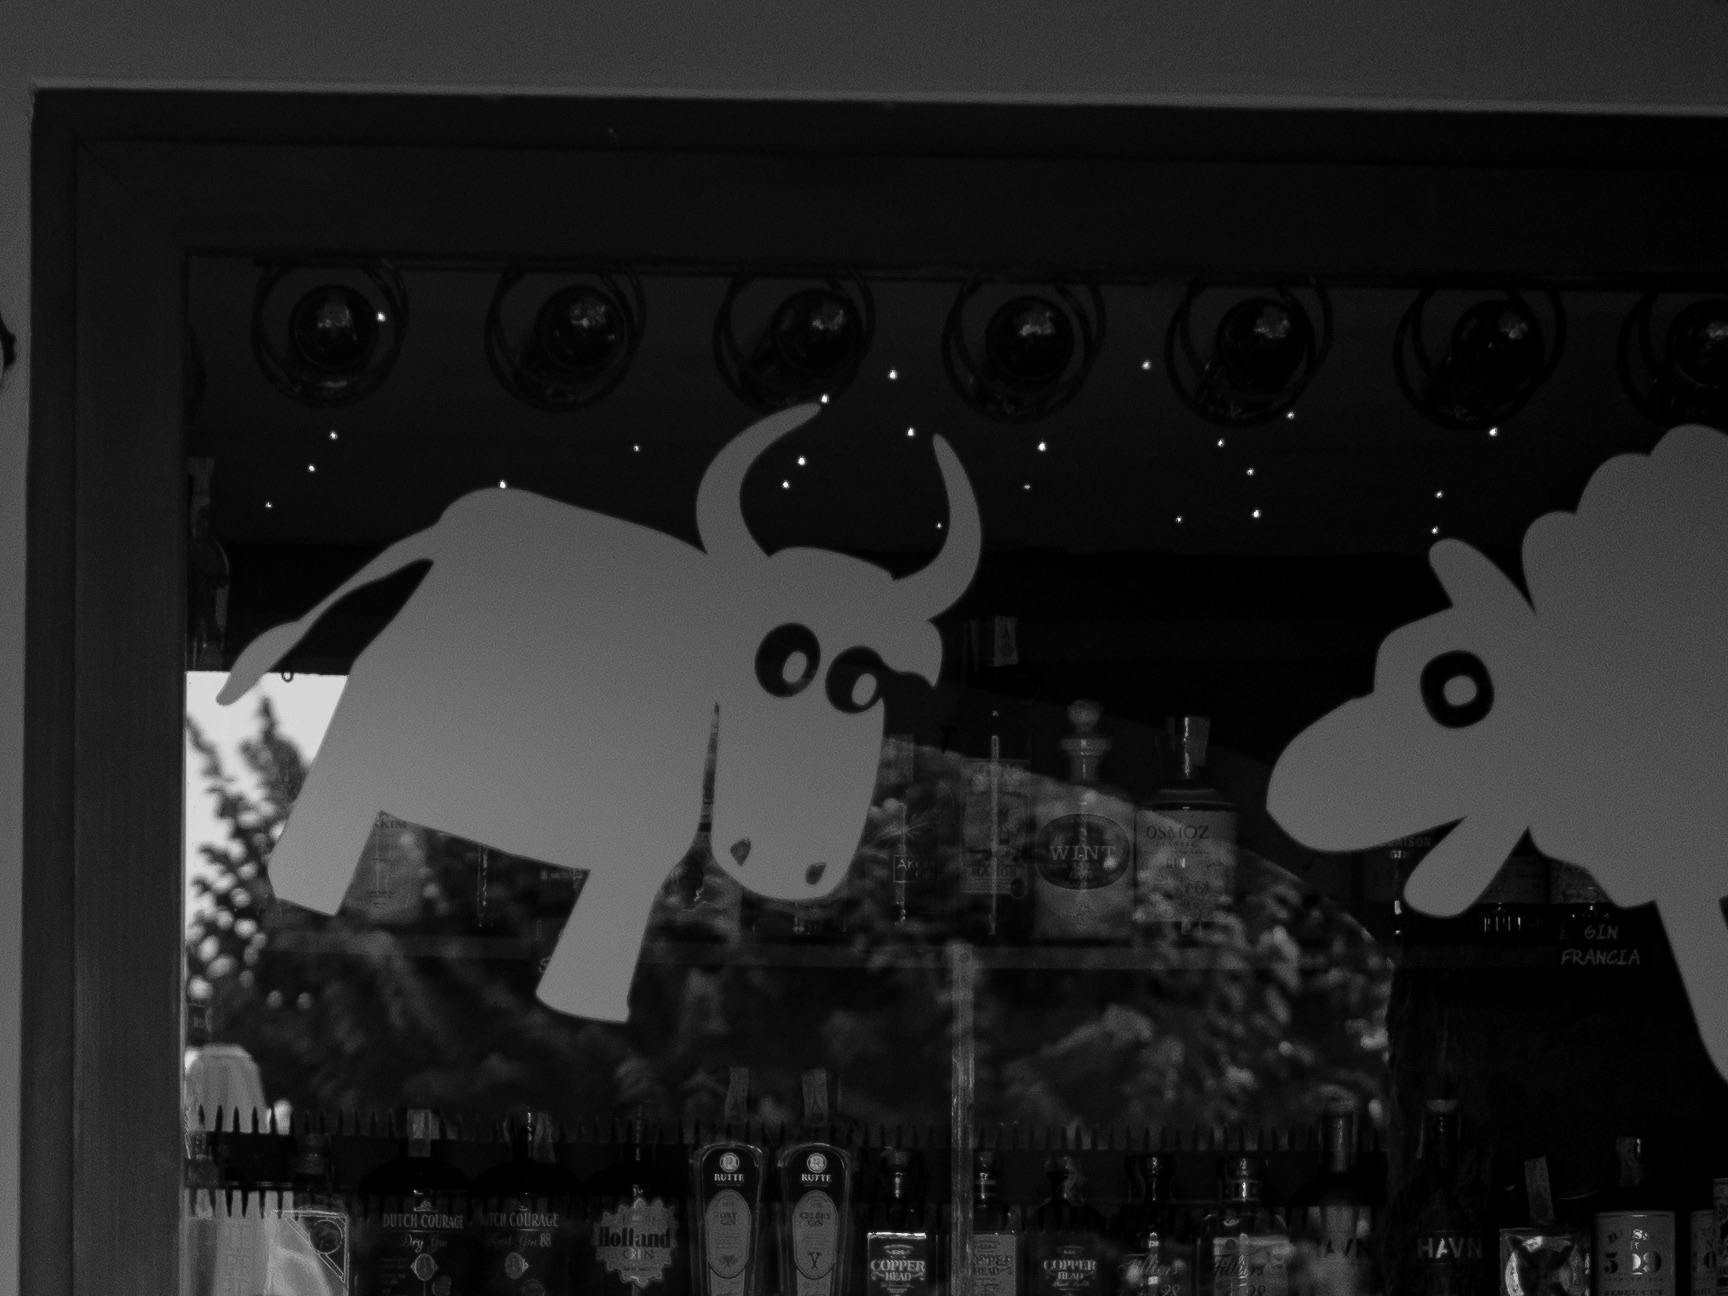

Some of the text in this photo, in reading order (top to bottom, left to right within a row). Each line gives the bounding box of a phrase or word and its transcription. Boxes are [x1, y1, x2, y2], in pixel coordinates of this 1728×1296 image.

[1584, 925, 1618, 940] GIN
[1561, 949, 1640, 966] FRANCIA
[382, 1213, 465, 1230] DUTCH COURAGE
[509, 1213, 558, 1228] COURAGE
[1418, 1237, 1482, 1259] HAVN
[870, 1260, 926, 1273] COPPER
